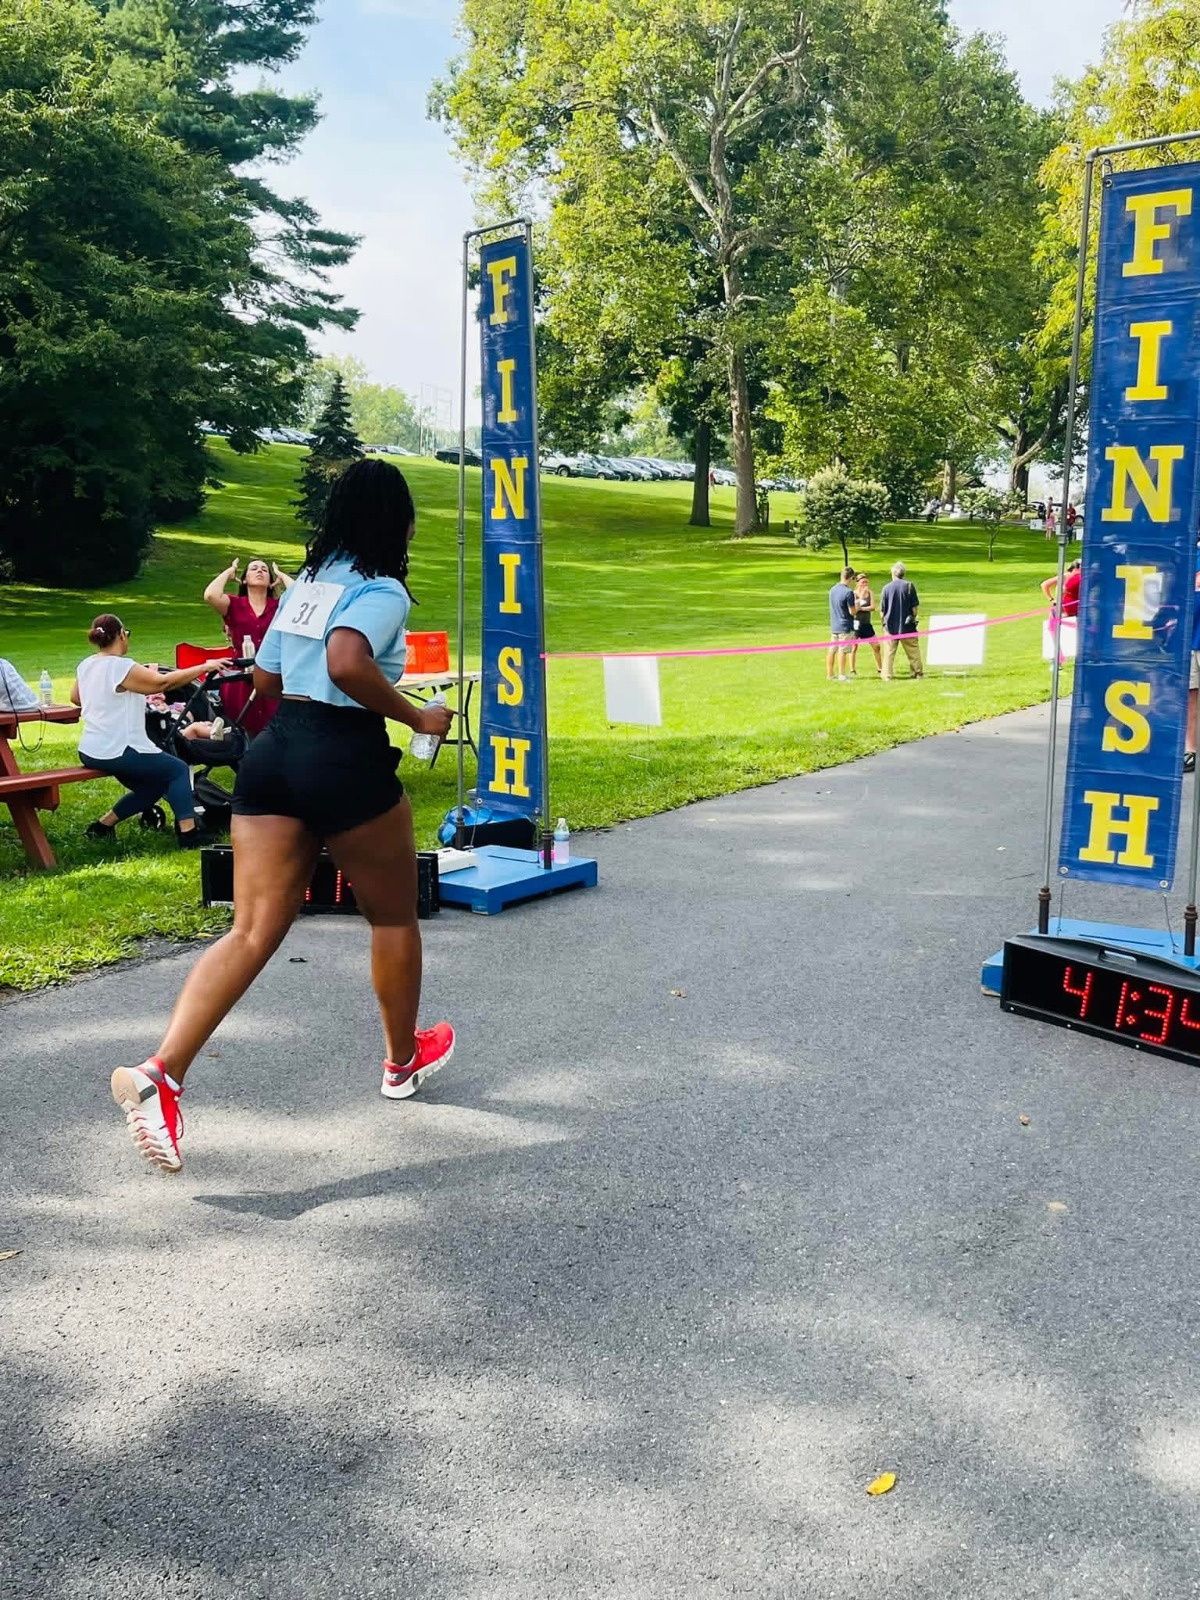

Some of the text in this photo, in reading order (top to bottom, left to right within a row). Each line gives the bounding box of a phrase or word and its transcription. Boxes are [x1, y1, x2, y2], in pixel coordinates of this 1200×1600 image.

[292, 602, 318, 625] 31
[487, 255, 531, 797] FINISH
[1079, 188, 1193, 868] FINISH
